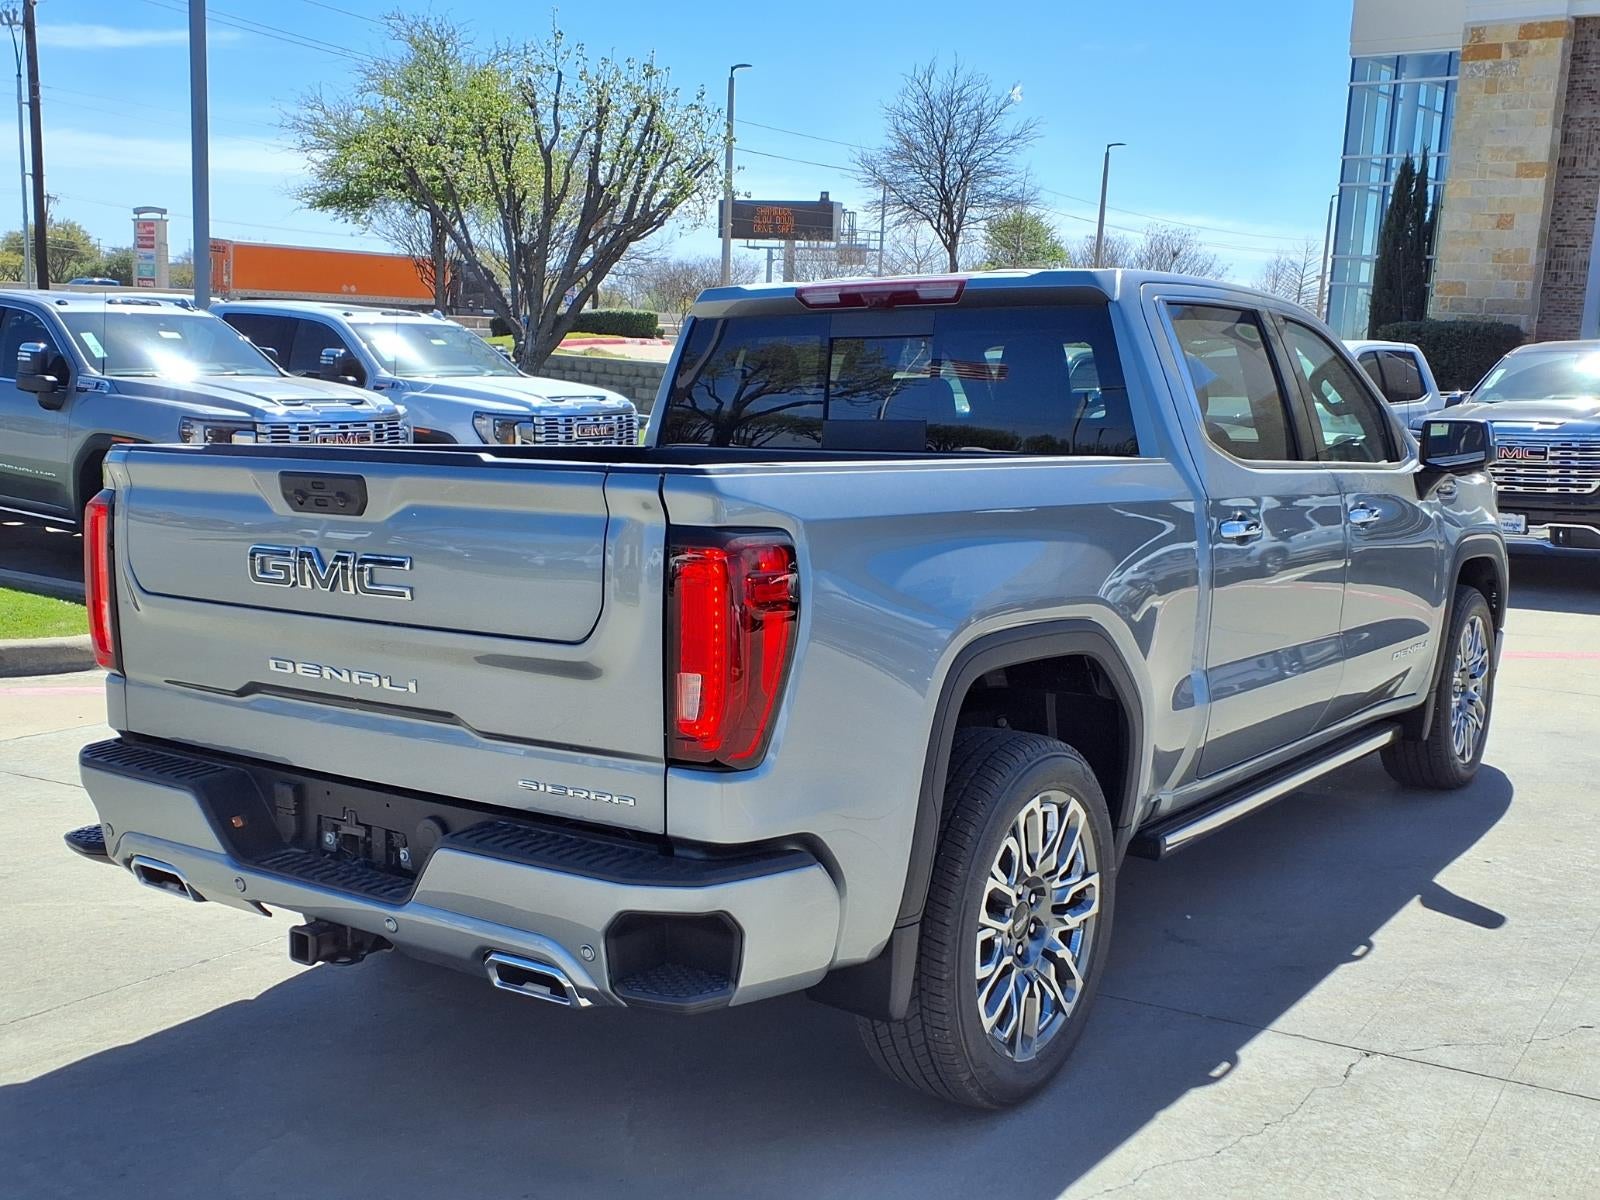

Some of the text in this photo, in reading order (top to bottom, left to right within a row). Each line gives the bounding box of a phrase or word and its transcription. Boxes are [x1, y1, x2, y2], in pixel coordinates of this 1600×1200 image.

[753, 215, 795, 225] SLOW DOWN
[753, 224, 796, 234] DRIVE SAFE
[579, 424, 615, 436] GMC
[318, 432, 371, 444] GMC
[1498, 446, 1545, 459] MC
[247, 544, 413, 601] GMC
[268, 656, 418, 694] DENALI
[517, 779, 636, 807] SIERRA
